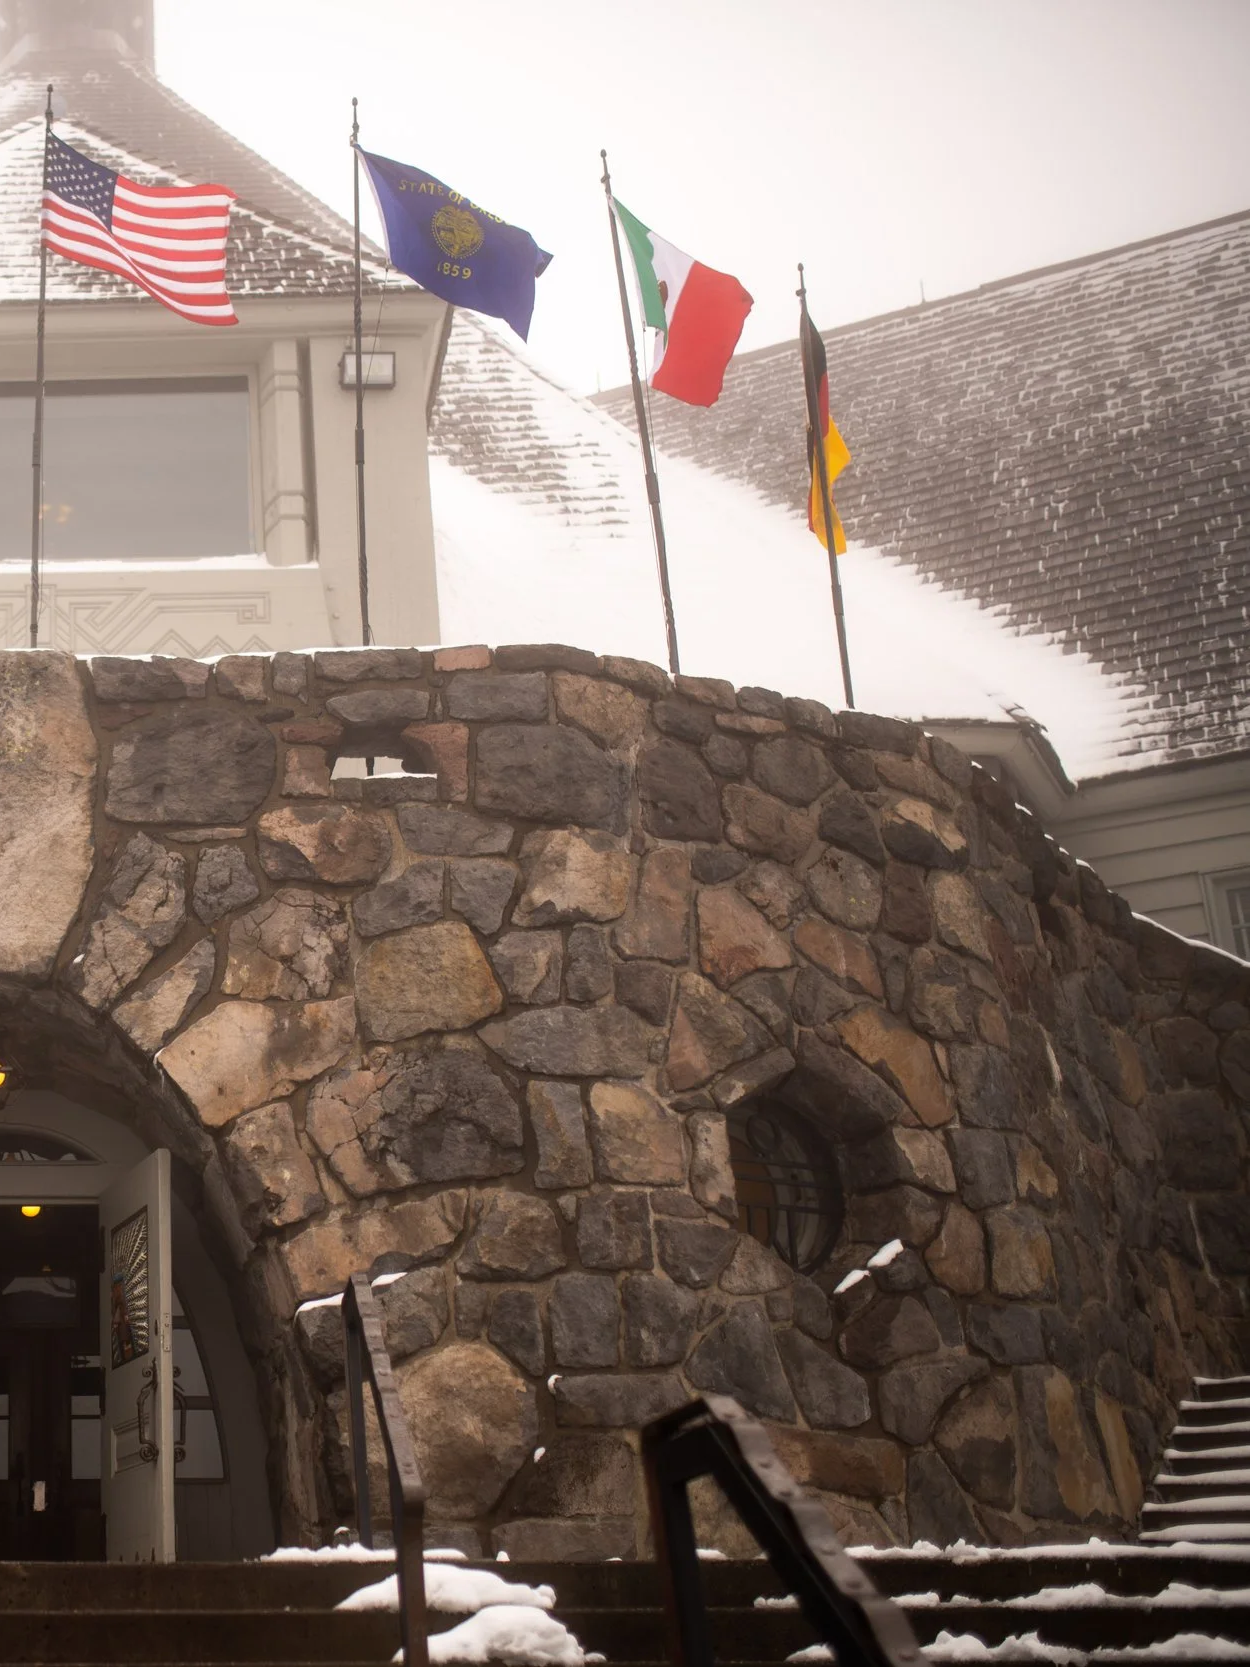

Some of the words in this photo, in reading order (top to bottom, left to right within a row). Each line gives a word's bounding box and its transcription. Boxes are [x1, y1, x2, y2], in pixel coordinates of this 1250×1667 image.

[399, 180, 444, 196] STATE
[448, 190, 465, 205] OF
[437, 262, 472, 279] 1859
